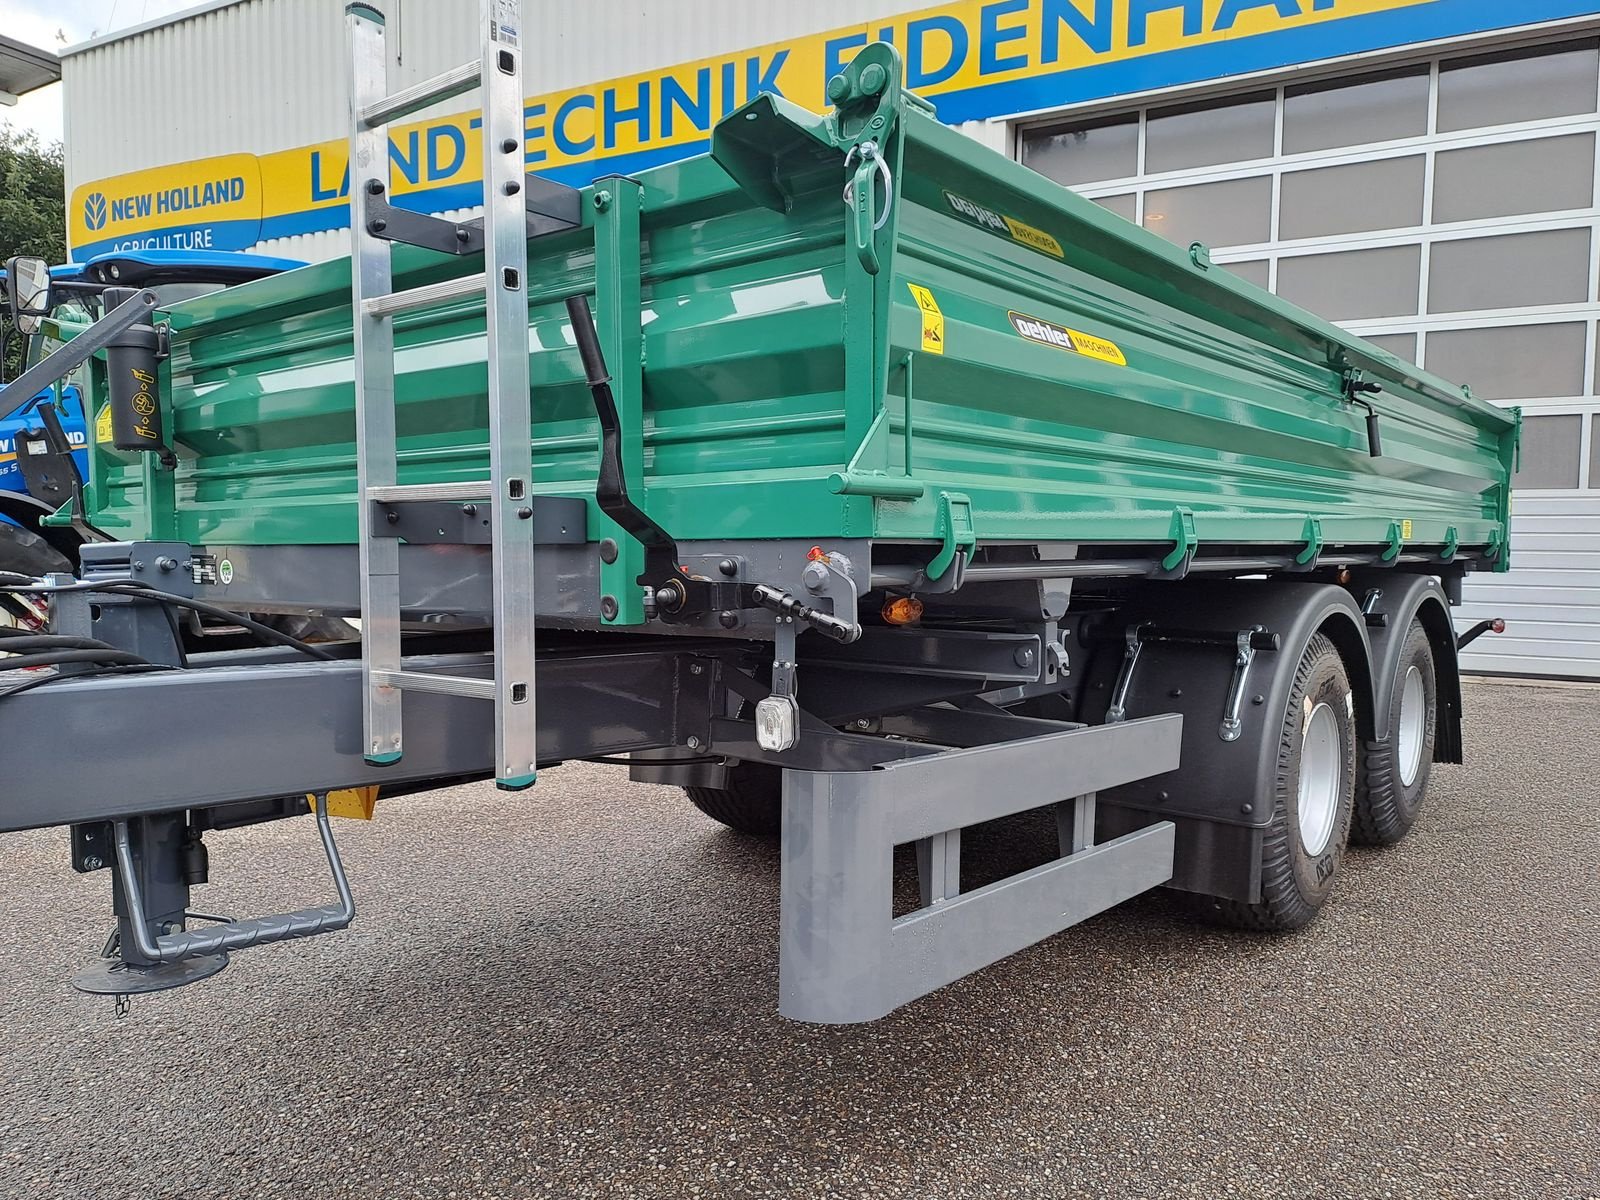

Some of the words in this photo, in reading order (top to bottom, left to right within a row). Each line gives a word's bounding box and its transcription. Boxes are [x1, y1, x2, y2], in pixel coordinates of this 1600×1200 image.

[311, 49, 790, 202] LNDECHNIK
[824, 0, 1334, 107] EDENH
[111, 194, 152, 221] NEW
[156, 176, 244, 214] HOLLAND
[1015, 318, 1072, 348] oehler
[1074, 336, 1120, 359] MASCHINEN
